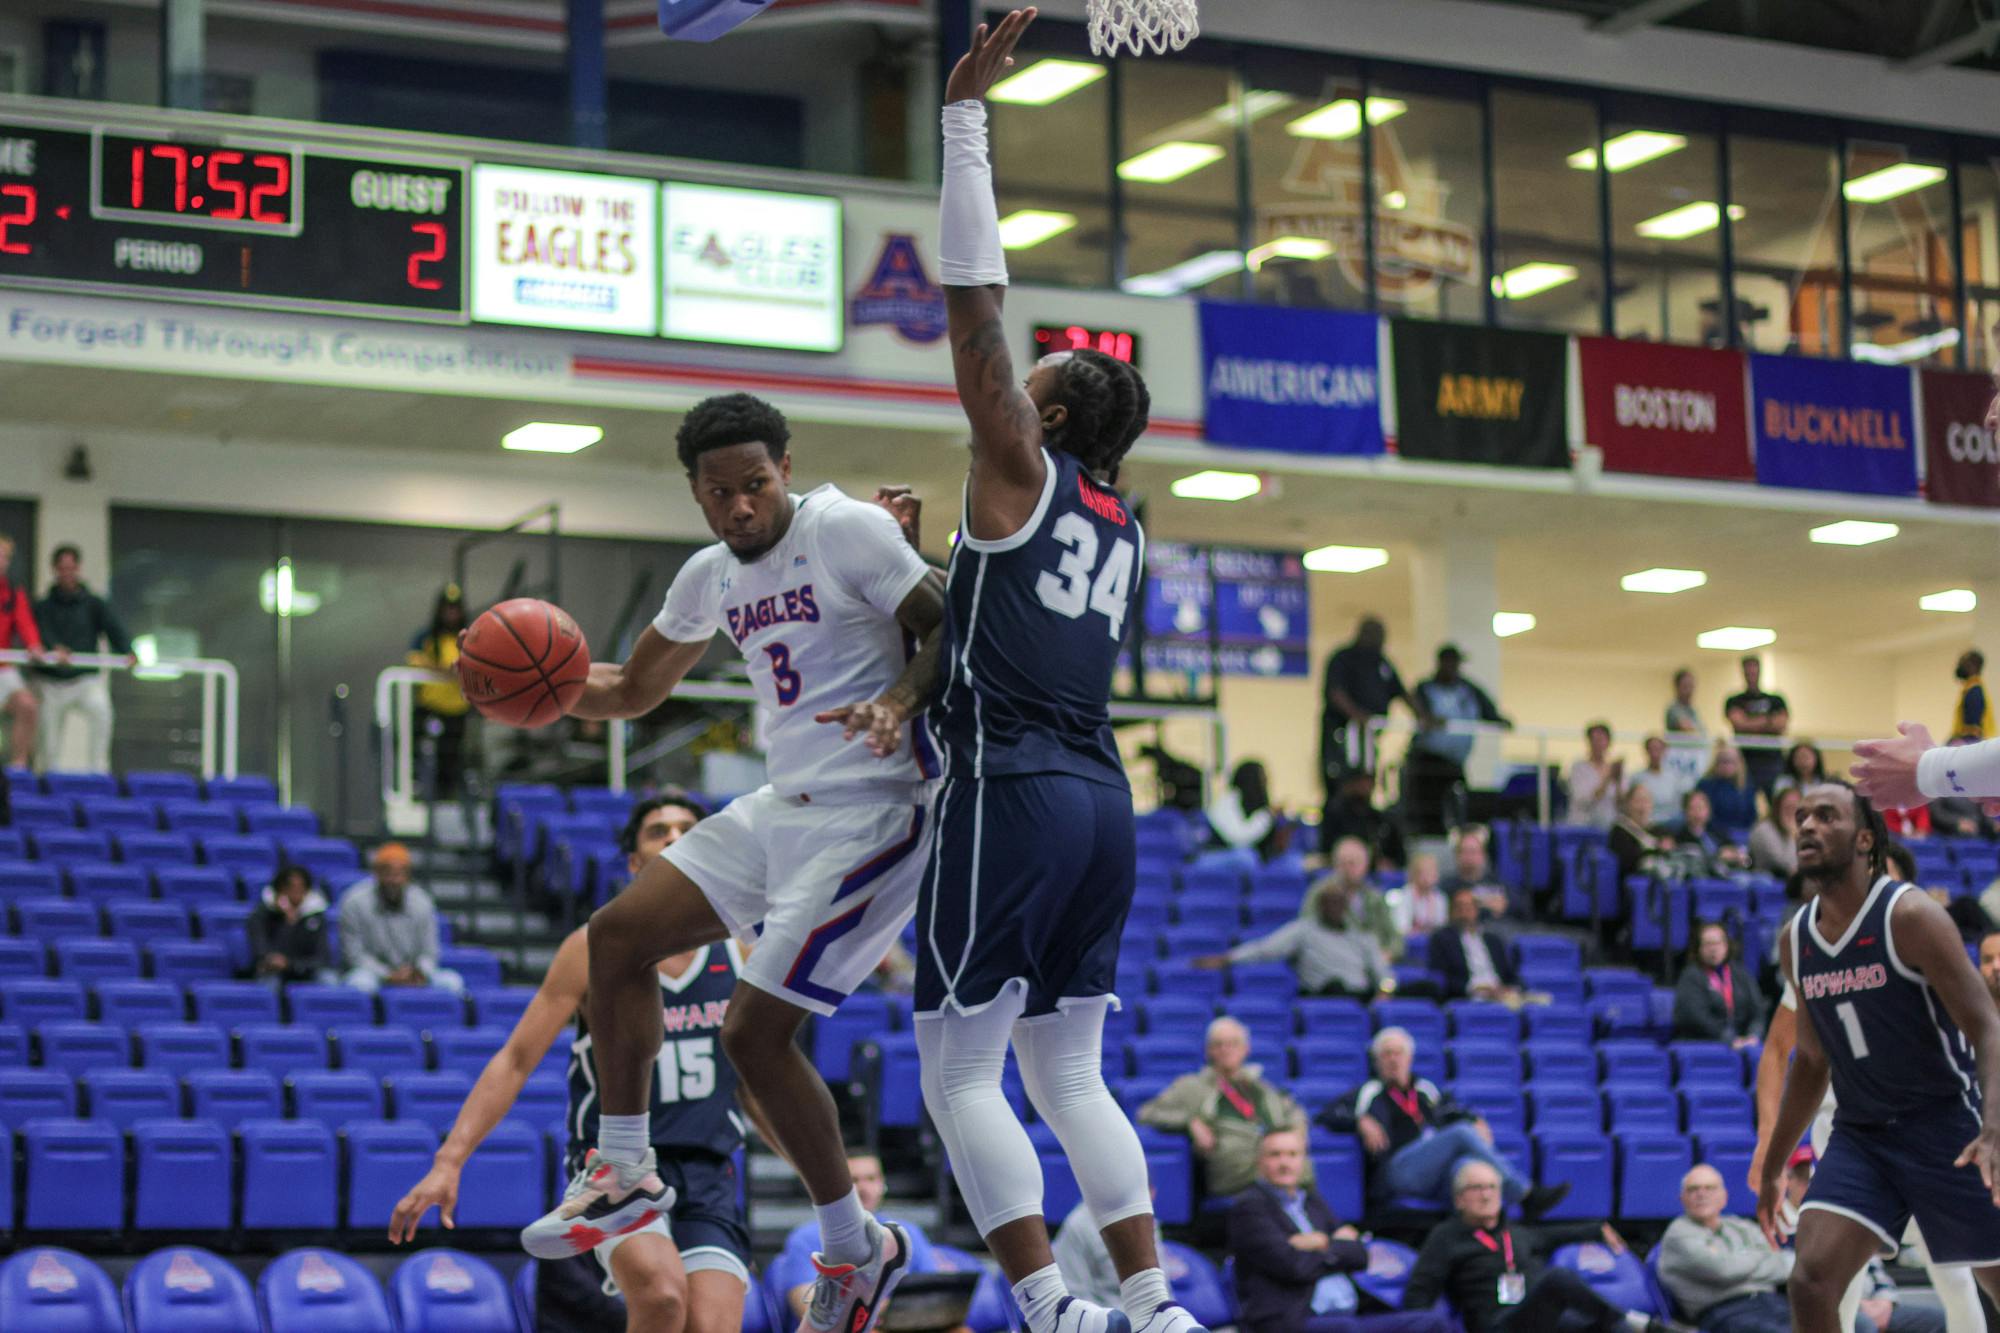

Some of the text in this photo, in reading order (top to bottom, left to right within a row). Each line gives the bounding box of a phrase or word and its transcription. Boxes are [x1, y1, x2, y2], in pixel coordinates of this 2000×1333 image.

[131, 144, 290, 224] 17:52
[351, 171, 452, 214] GUEST
[0, 184, 37, 254] 2
[114, 239, 203, 275] PERIOD
[406, 222, 447, 290] 2
[496, 222, 636, 276] EAGLES
[8, 307, 560, 377] Forged Through Competition
[1208, 355, 1378, 408] AMERICAN
[1437, 373, 1524, 420] ARMY
[1614, 383, 1716, 433] BOSTON
[1764, 399, 1906, 449] BUCKNELL
[1034, 511, 1135, 642] 34
[726, 584, 820, 646] EAGLES
[762, 641, 802, 707] 3
[1802, 962, 1888, 1000] HOWARD
[1835, 1001, 1870, 1060] 1
[656, 1036, 716, 1104] 15
